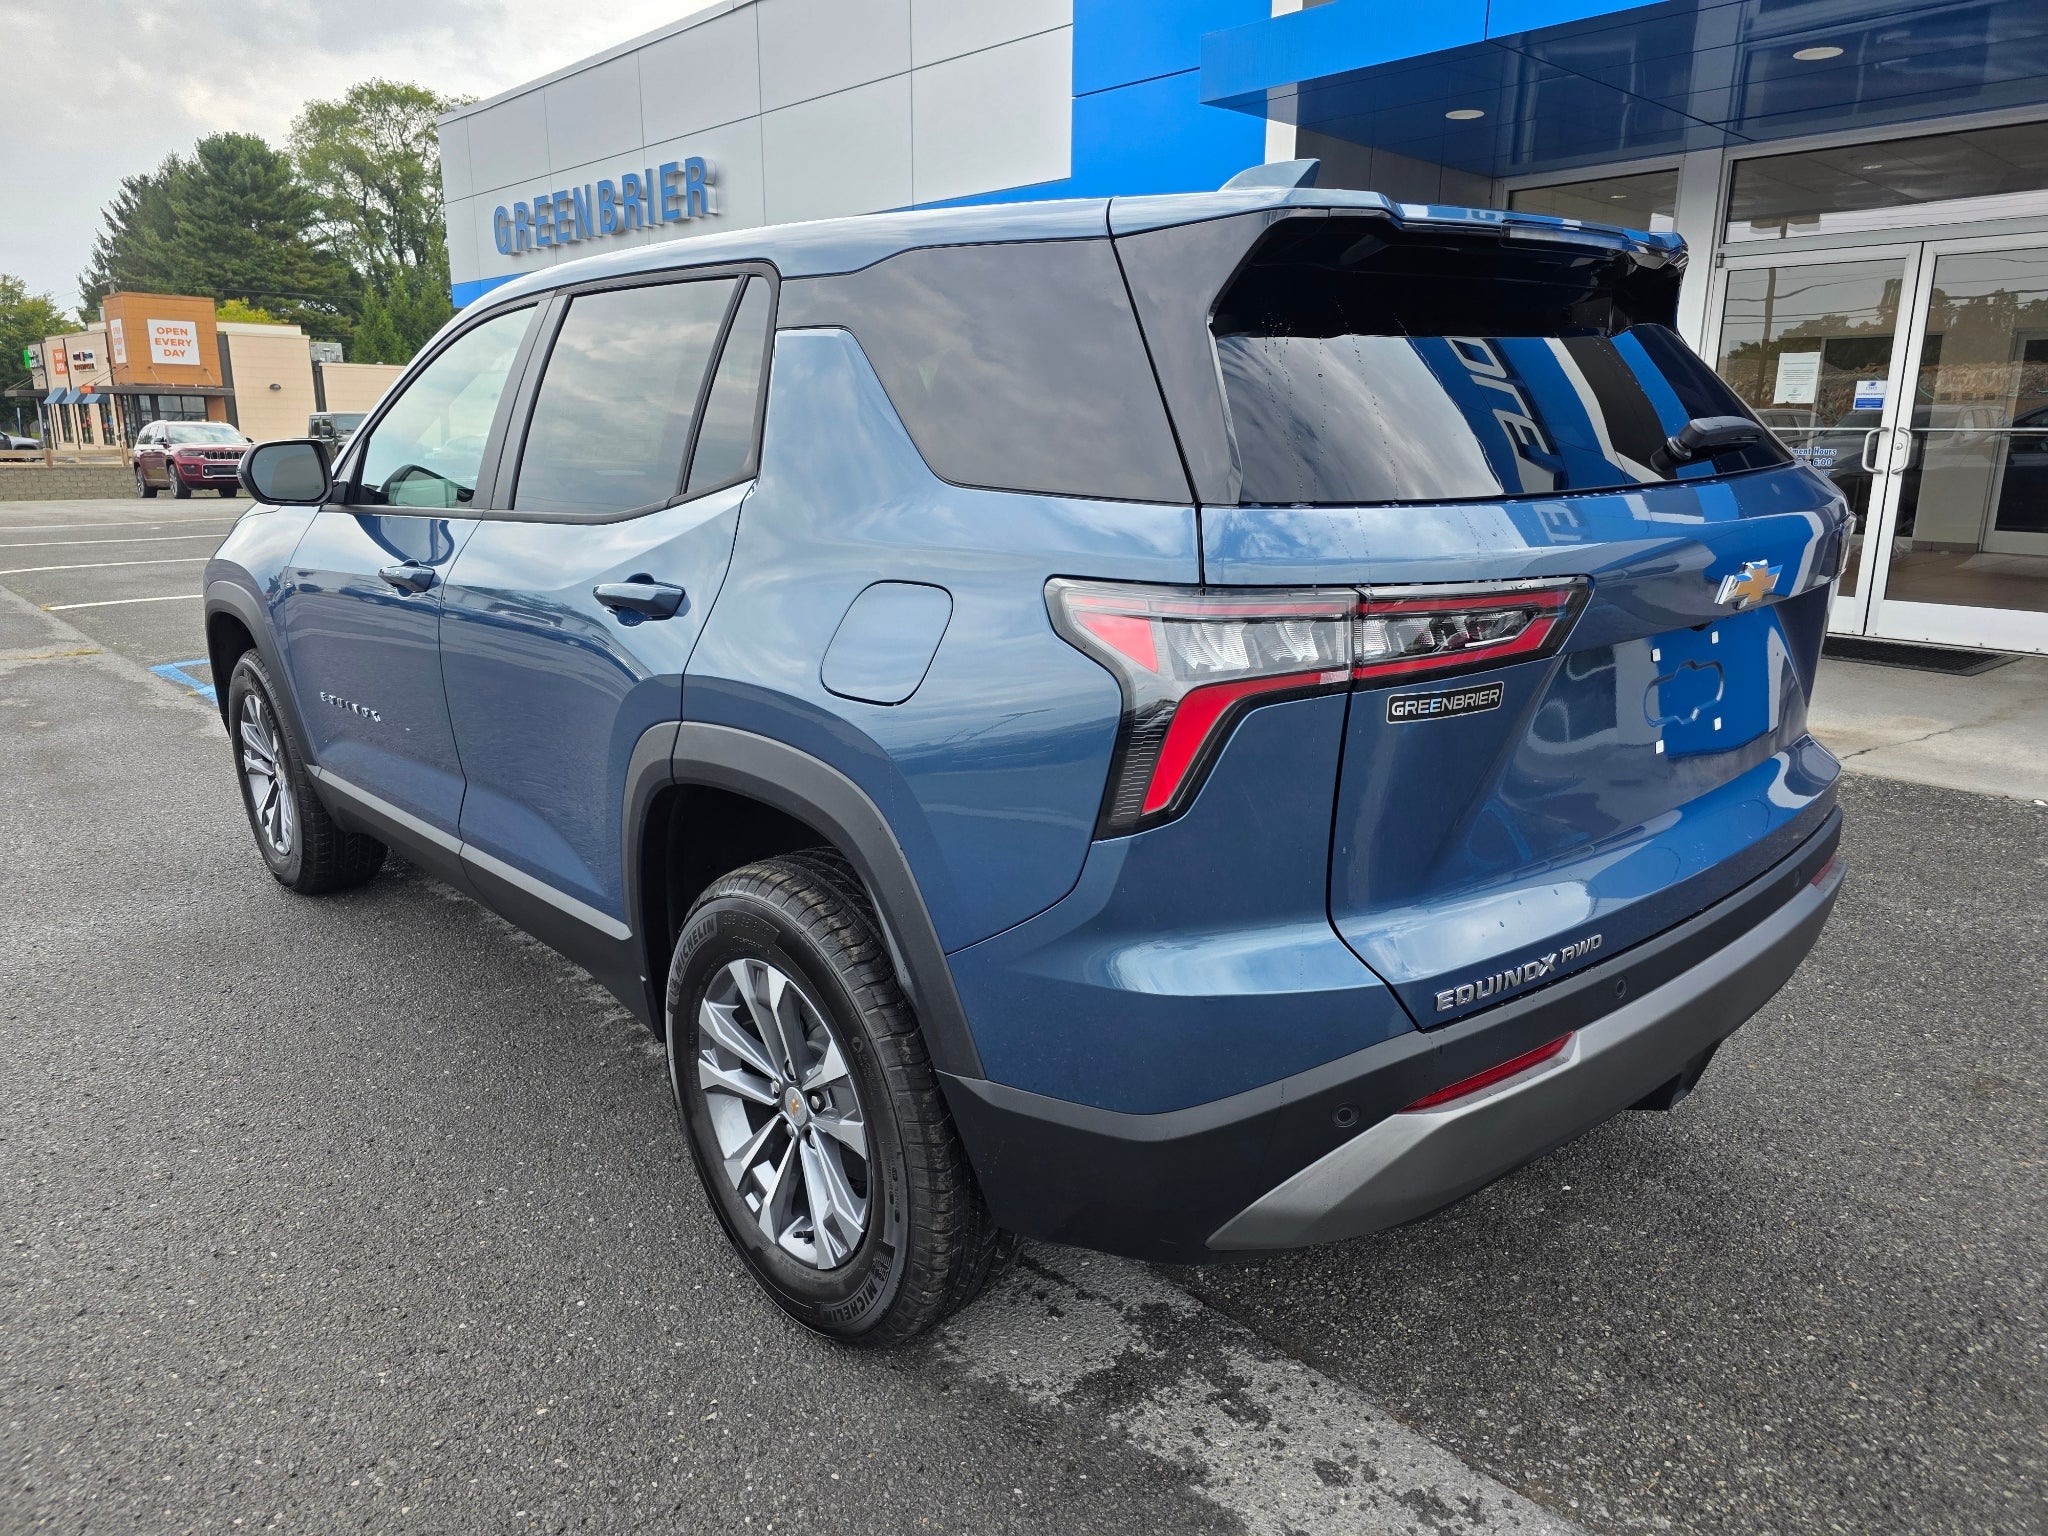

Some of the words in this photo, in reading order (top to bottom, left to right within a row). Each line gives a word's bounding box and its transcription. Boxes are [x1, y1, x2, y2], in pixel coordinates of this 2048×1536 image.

[494, 156, 717, 255] GREENBRIER
[156, 326, 188, 336] OPEN
[154, 337, 192, 347] EVERY
[163, 349, 186, 358] DAY
[1813, 446, 1837, 456] Hours
[1813, 457, 1833, 467] 6:00
[1391, 688, 1501, 717] GREENBRIER
[674, 917, 716, 978] MICHELIN
[1434, 952, 1558, 1012] EQUINOX
[1560, 933, 1603, 965] AWD
[823, 1278, 879, 1323] MICHELIN
